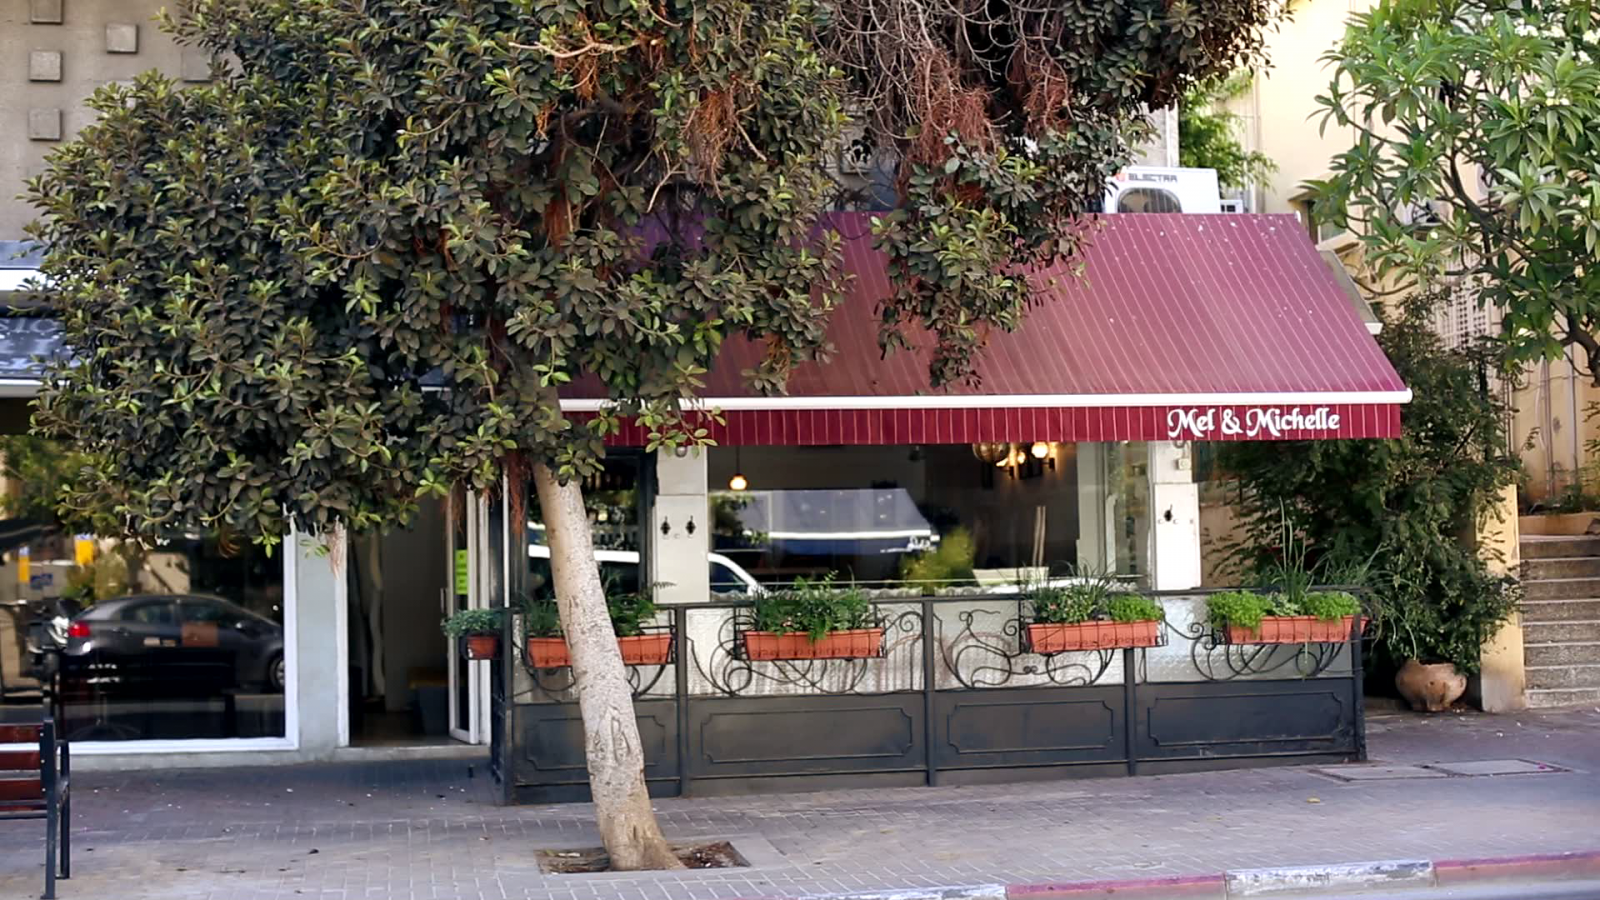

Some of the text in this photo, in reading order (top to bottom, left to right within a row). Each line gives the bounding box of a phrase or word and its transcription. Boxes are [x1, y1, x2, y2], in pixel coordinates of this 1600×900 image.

[1128, 173, 1178, 183] ELECTRA
[1167, 407, 1339, 437] Mel & Michelle
